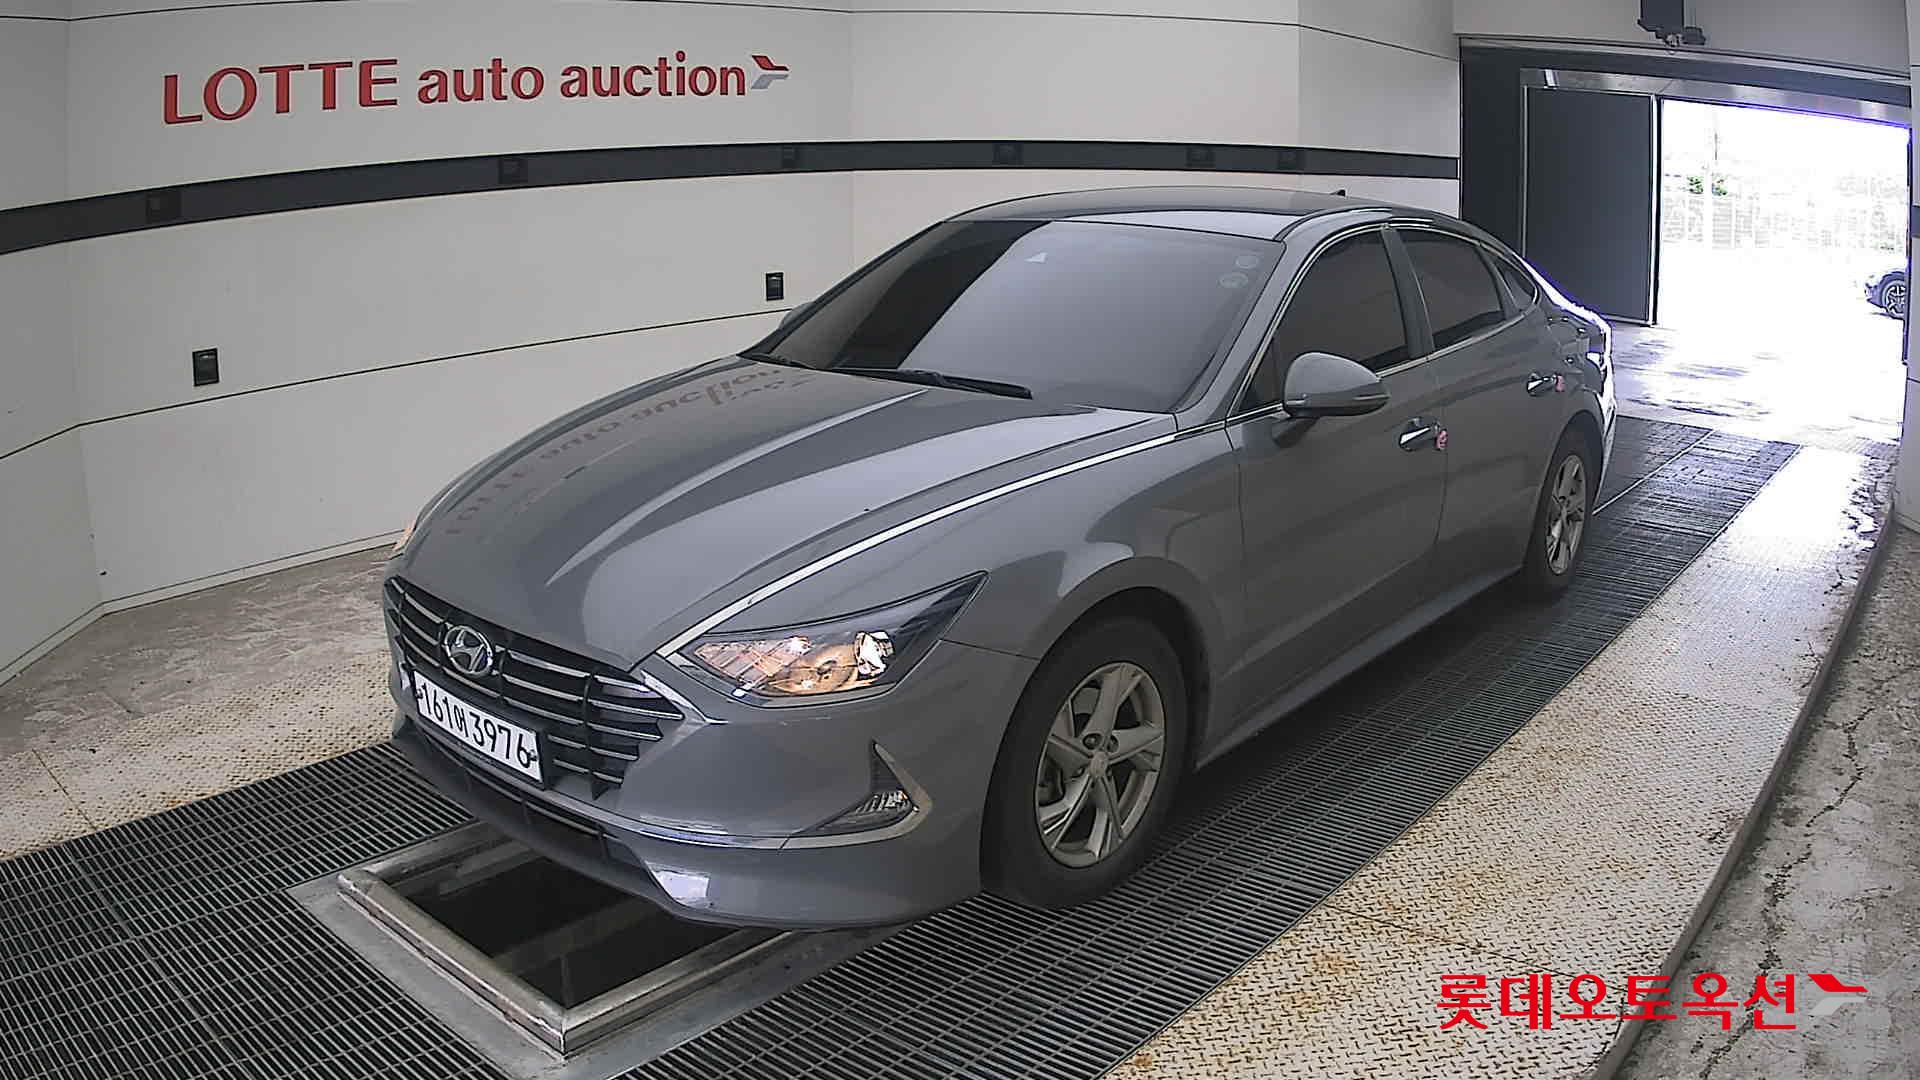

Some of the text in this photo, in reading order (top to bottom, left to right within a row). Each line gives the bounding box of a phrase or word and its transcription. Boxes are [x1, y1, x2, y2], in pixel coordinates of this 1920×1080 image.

[163, 50, 747, 125] LOTTE auto auction
